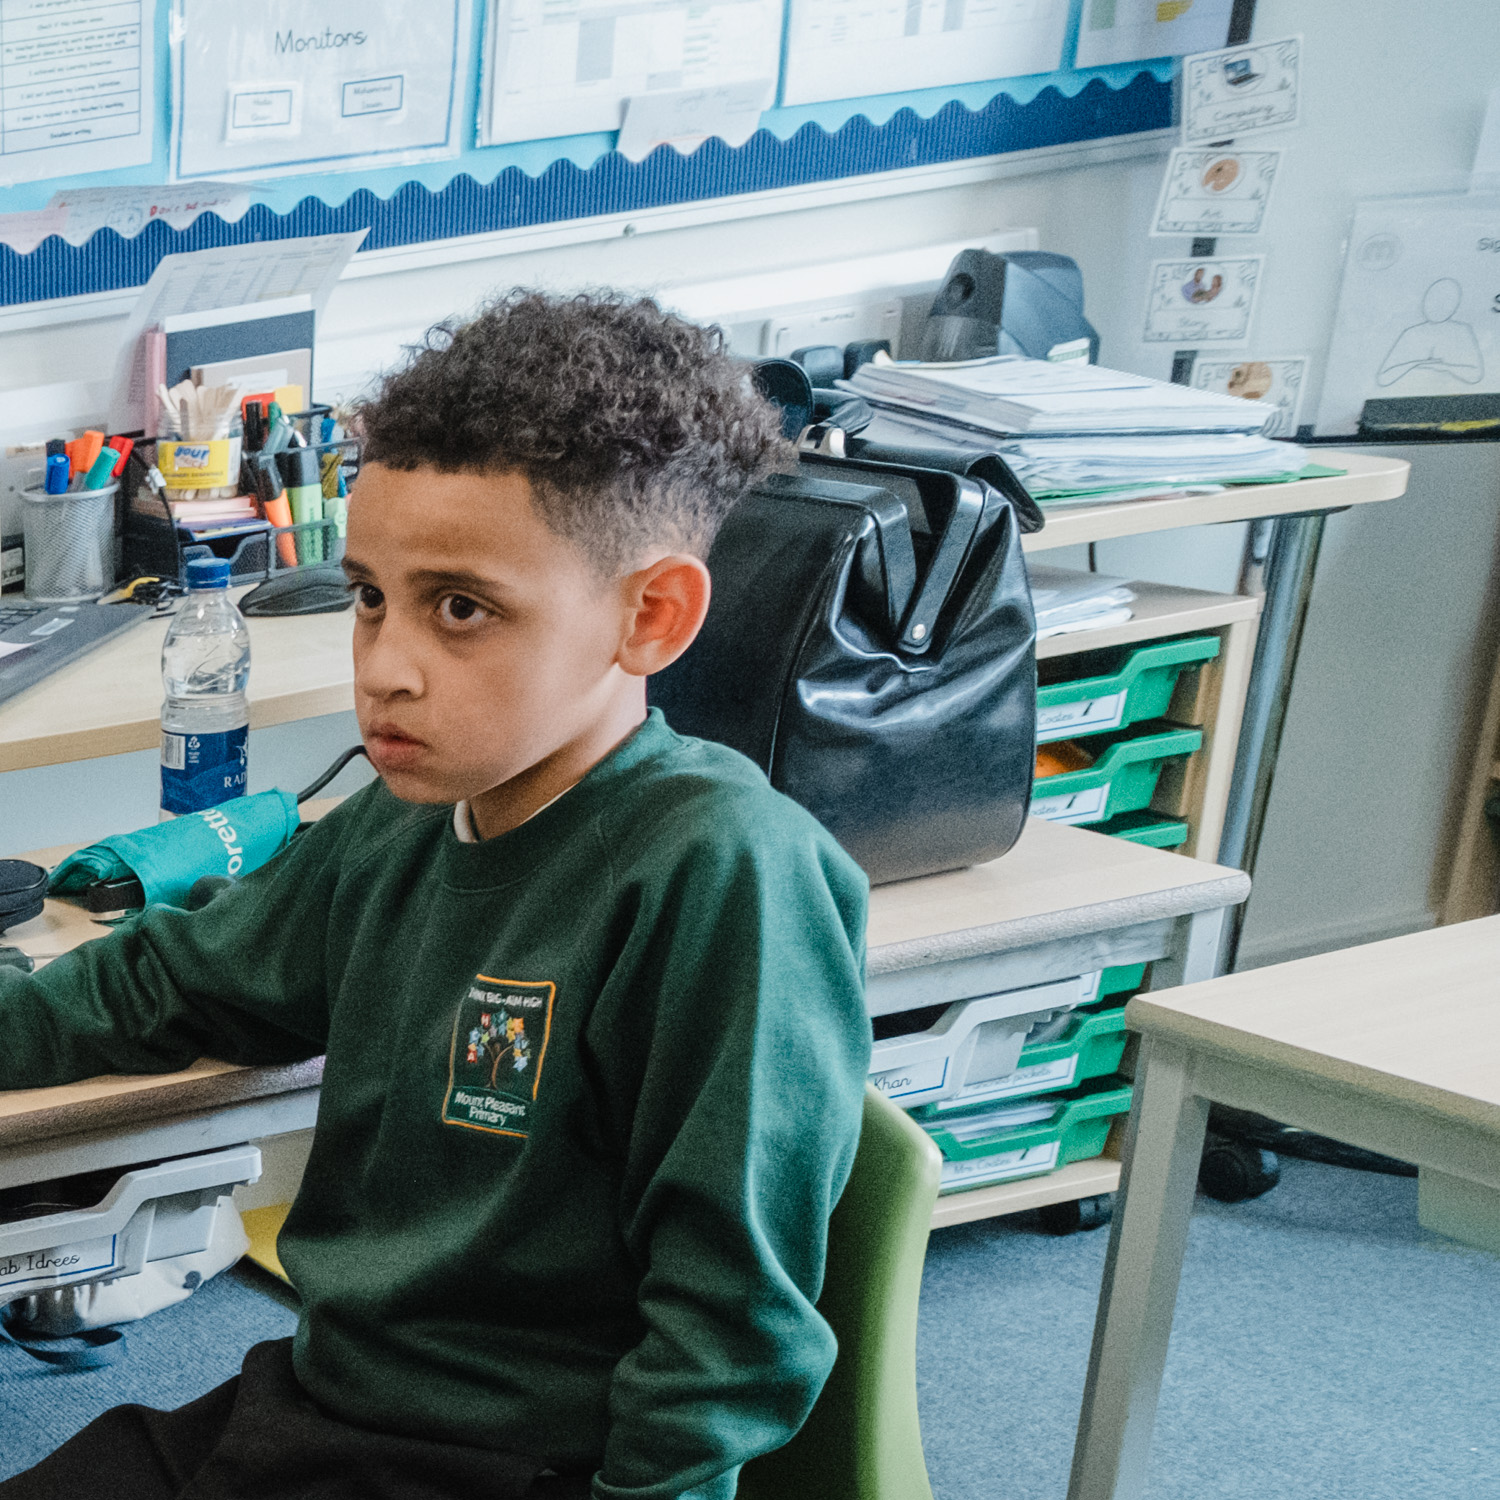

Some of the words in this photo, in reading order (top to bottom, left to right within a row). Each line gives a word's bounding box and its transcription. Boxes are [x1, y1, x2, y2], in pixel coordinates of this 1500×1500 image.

[275, 26, 368, 55] Monitors
[874, 1076, 912, 1091] Khan
[469, 1106, 507, 1126] Primary
[26, 1253, 80, 1271] Idrees
